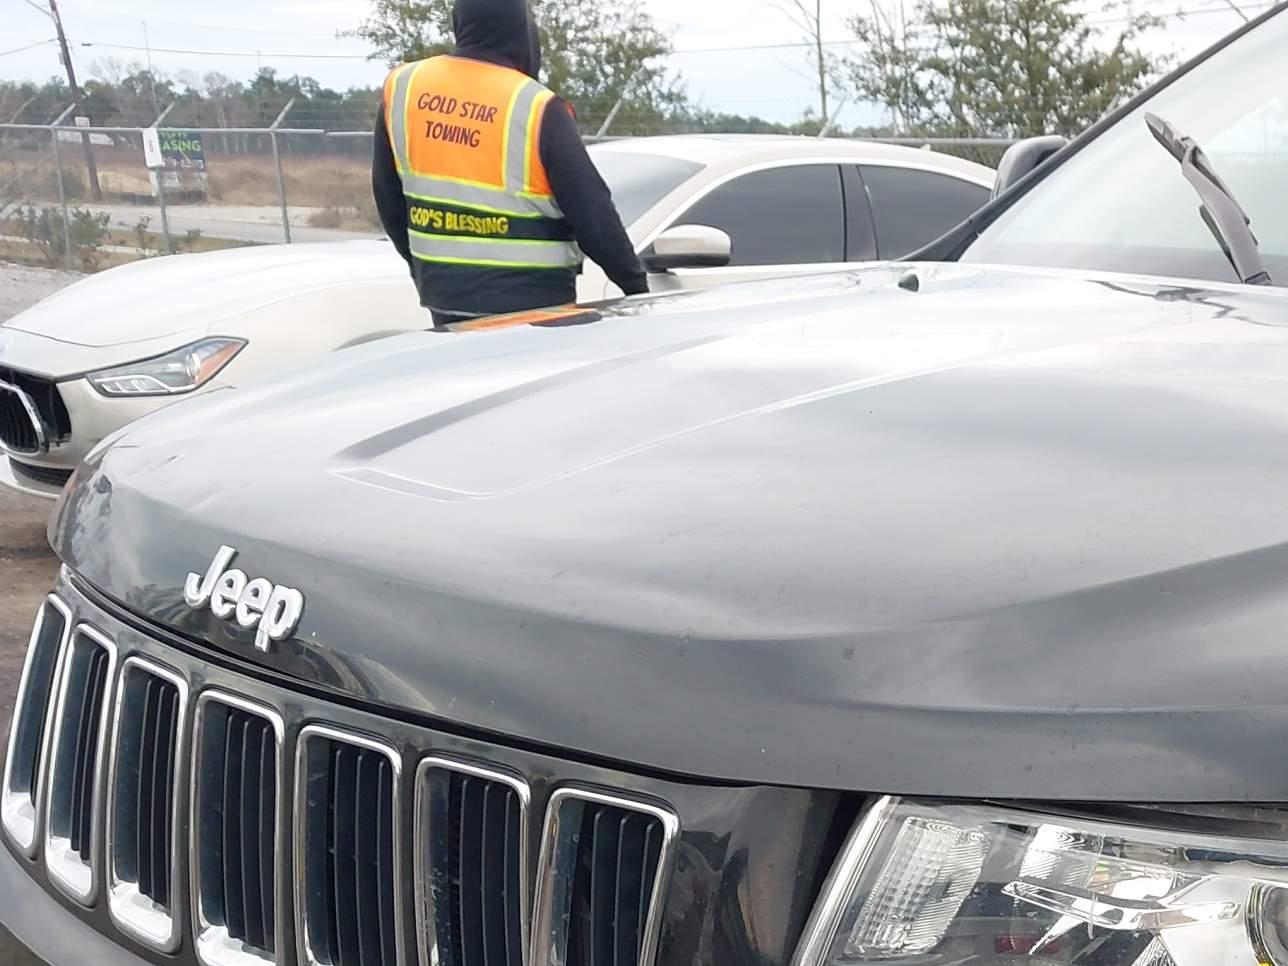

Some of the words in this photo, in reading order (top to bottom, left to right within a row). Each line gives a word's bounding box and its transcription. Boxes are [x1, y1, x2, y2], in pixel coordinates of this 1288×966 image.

[416, 92, 457, 114] GOLD
[459, 101, 498, 124] STAR
[424, 120, 481, 149] TOWING
[409, 206, 443, 229] GOD'S
[445, 212, 509, 234] BLESSING
[184, 545, 304, 653] Jeep
